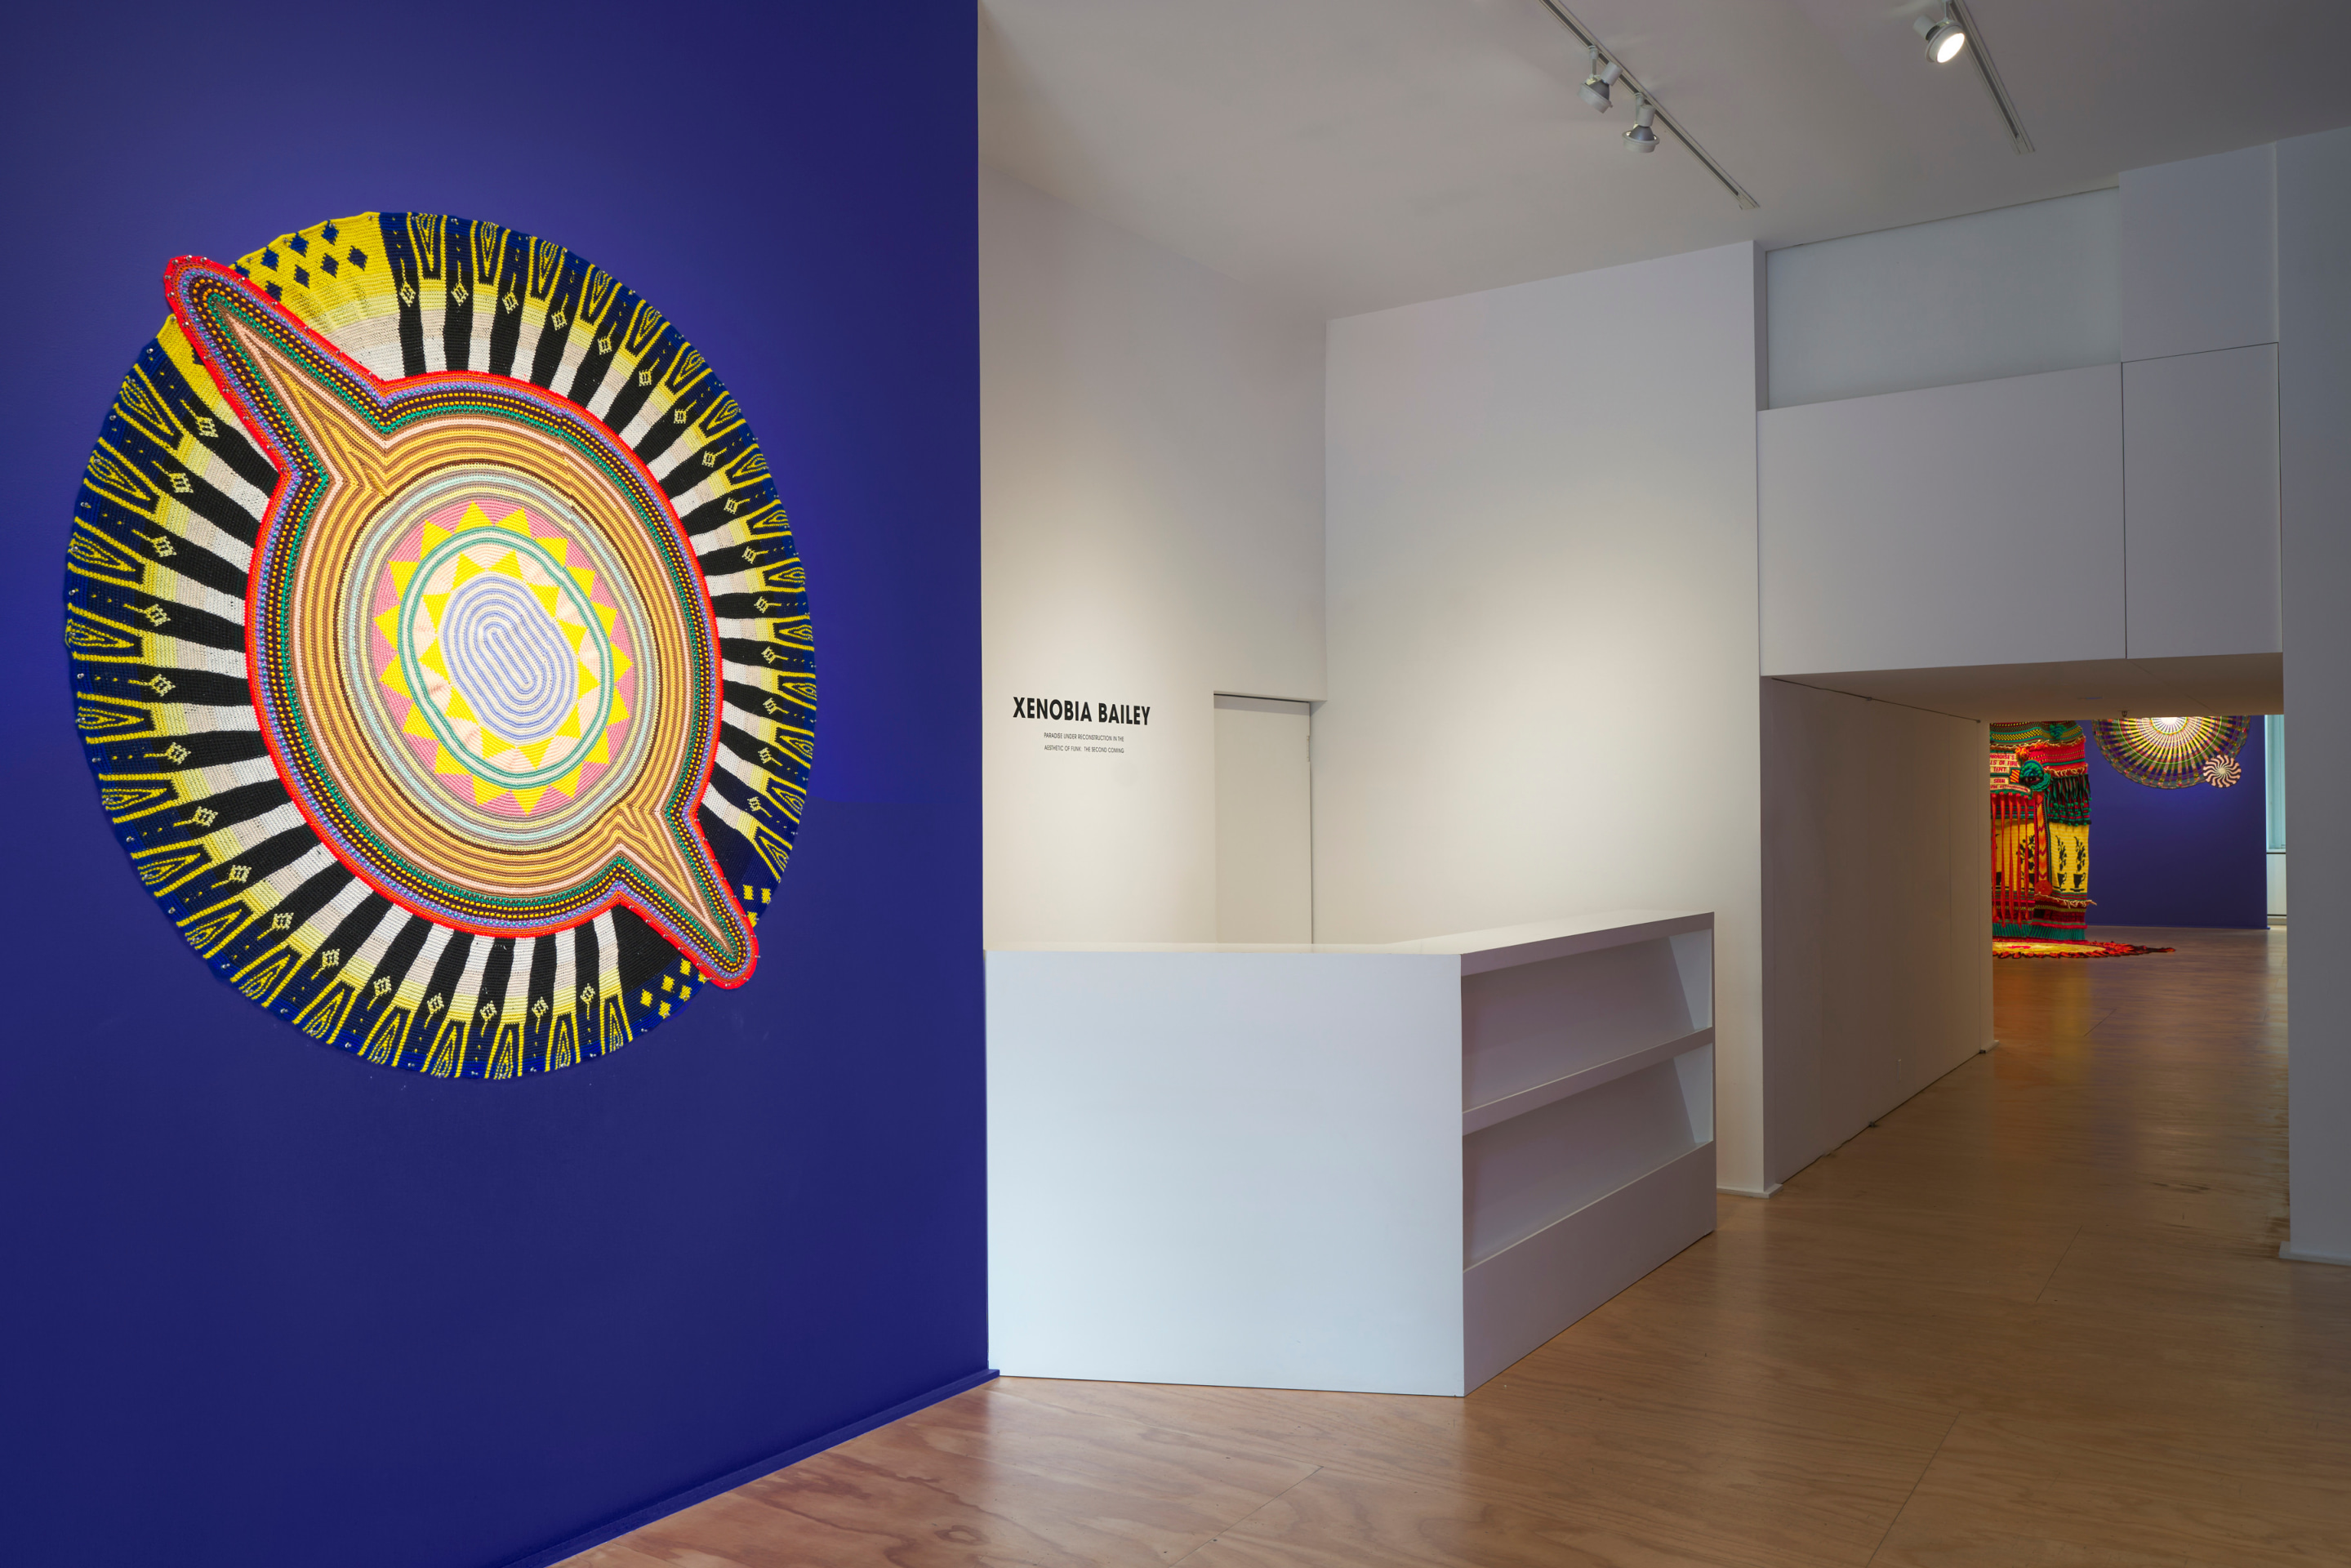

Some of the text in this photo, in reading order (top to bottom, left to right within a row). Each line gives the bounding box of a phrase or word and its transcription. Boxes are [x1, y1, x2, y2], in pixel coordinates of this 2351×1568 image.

[1013, 697, 1151, 725] XENOBIA BAILEY
[1077, 733, 1112, 742] RECONSTRUCTION
